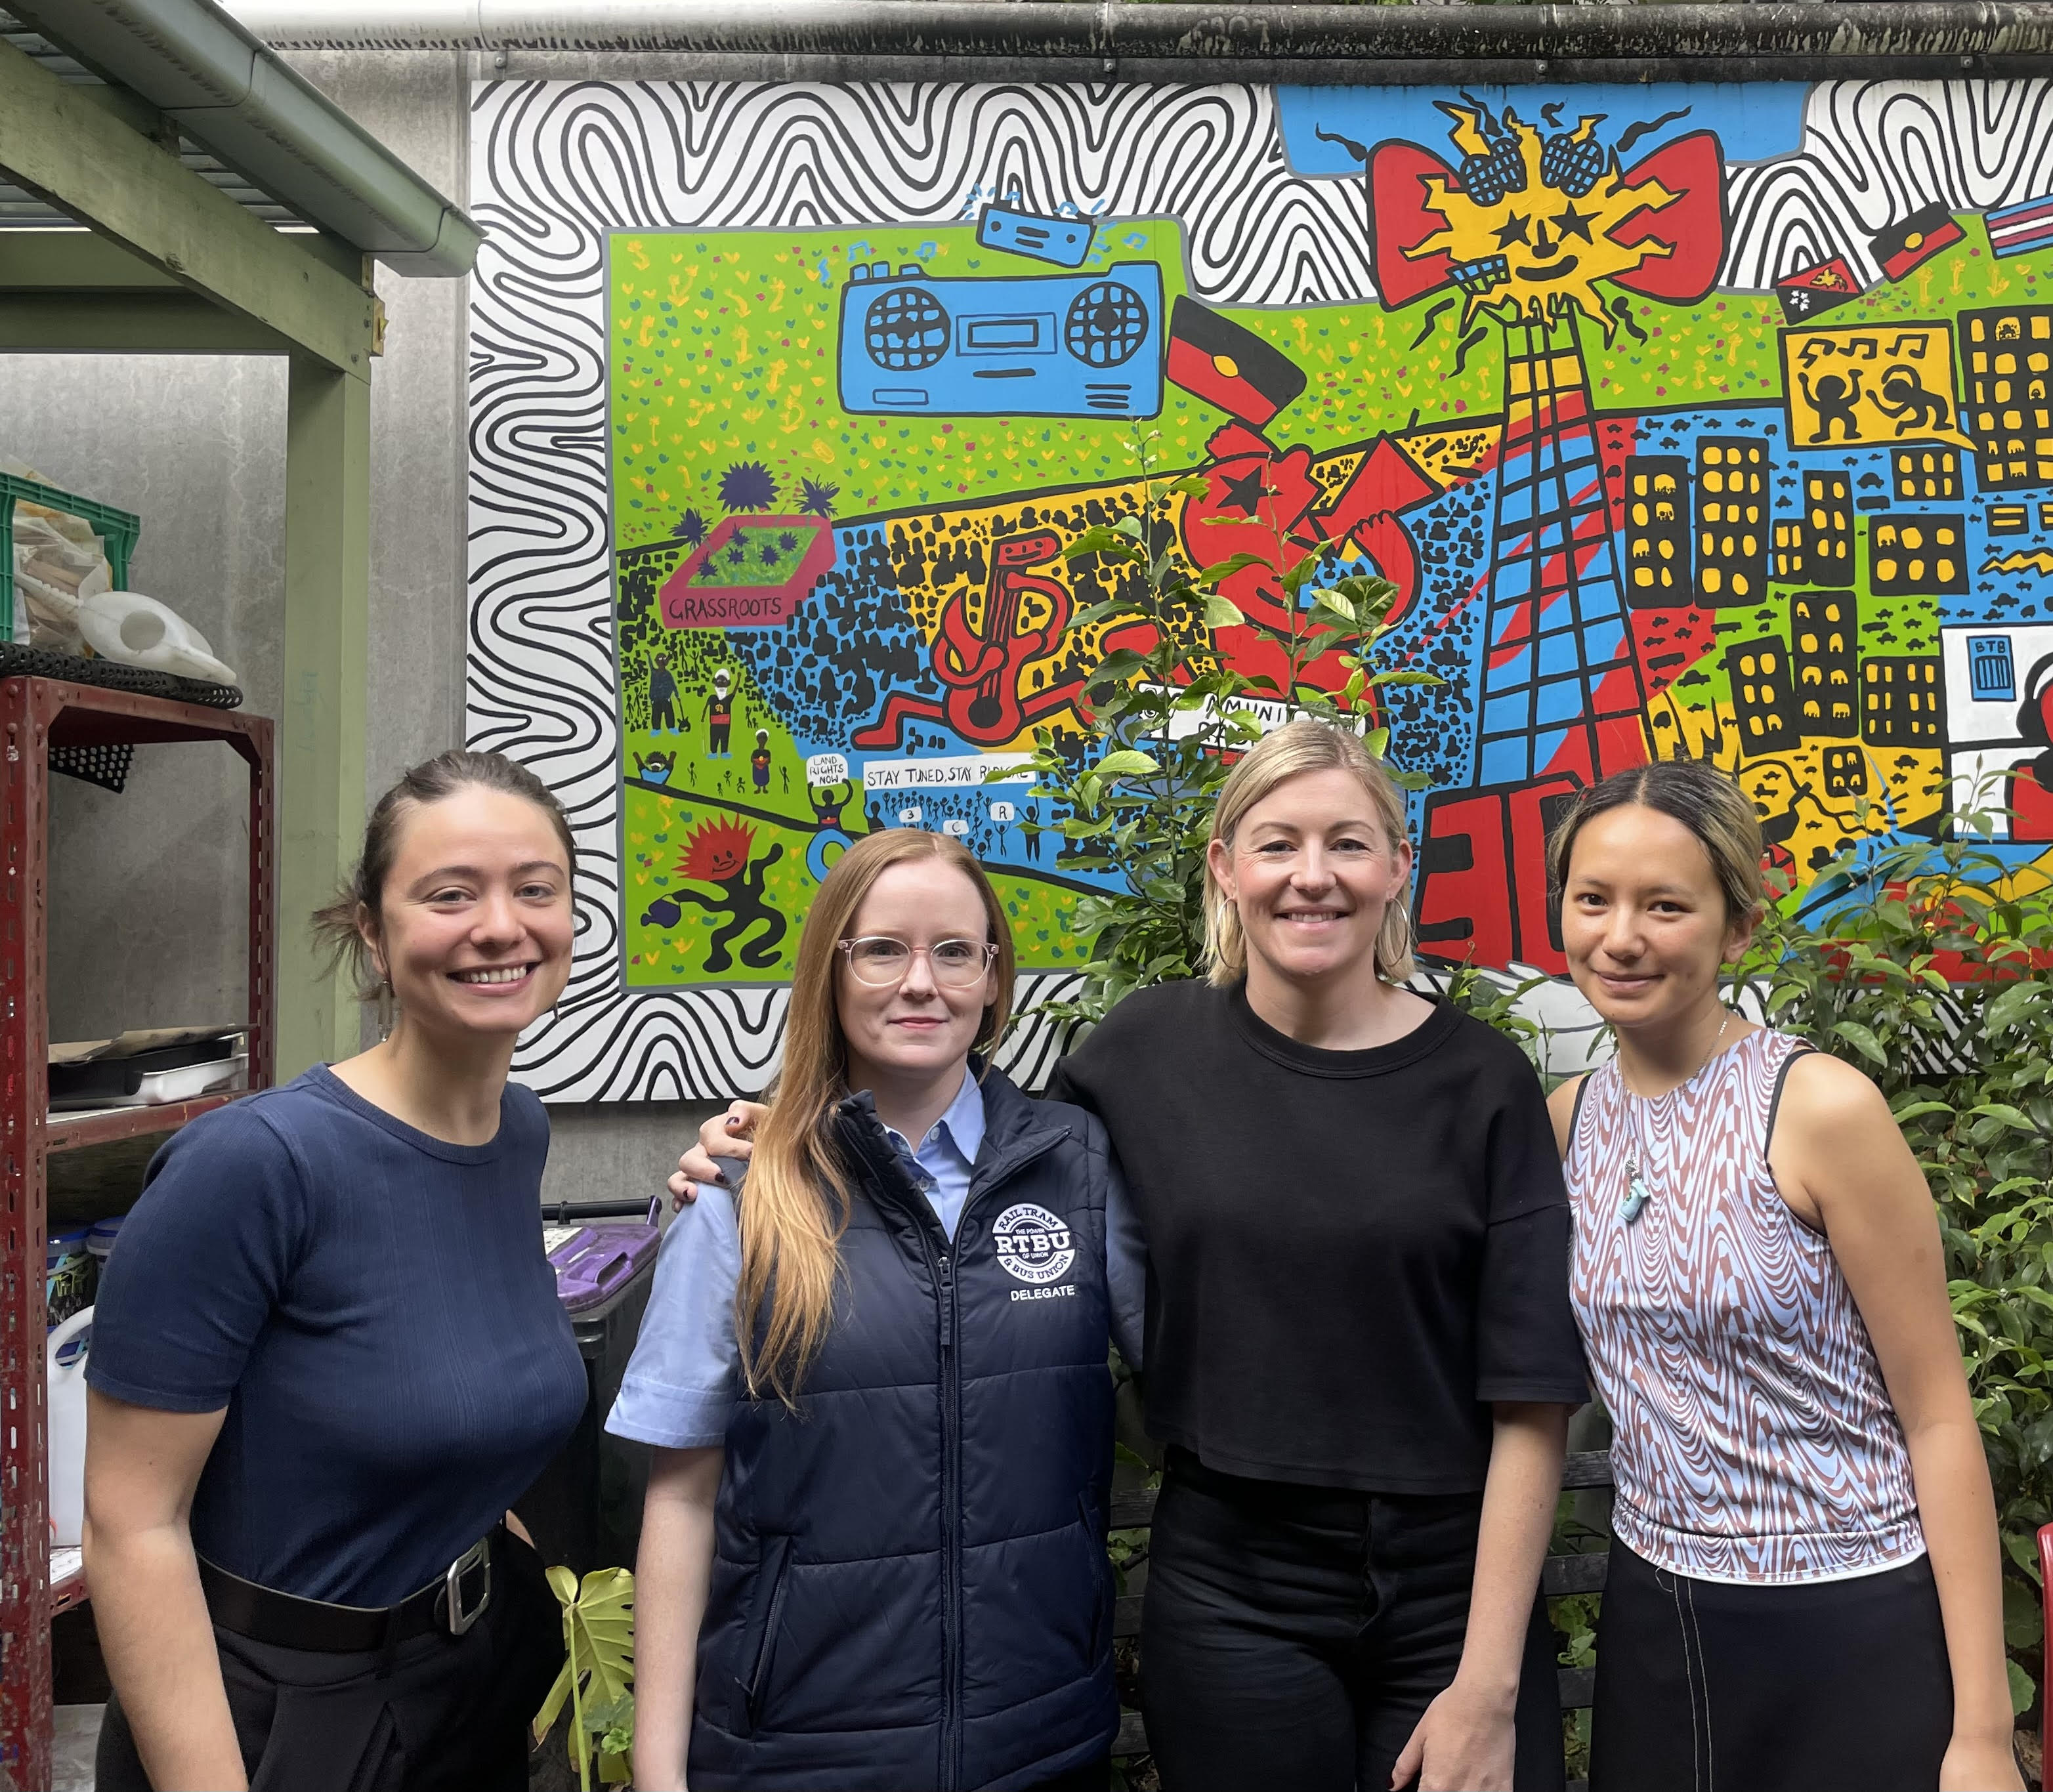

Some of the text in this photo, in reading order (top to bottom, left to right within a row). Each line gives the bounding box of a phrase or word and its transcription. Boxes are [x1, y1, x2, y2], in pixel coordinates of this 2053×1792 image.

[668, 597, 782, 621] GRASSROOTS
[1974, 640, 2006, 654] BTB
[813, 755, 837, 766] LAND
[809, 764, 844, 776] RIGHTS
[868, 770, 900, 786] STAY
[948, 766, 971, 781] STAY
[819, 775, 839, 785] NOW
[999, 805, 1007, 820] R
[998, 1207, 1059, 1230] RAIL TRAM
[994, 1231, 1070, 1254] RTBU
[1012, 1264, 1034, 1279] BUS
[1036, 1254, 1069, 1280] UNION
[1010, 1284, 1075, 1302] DELEGATE
